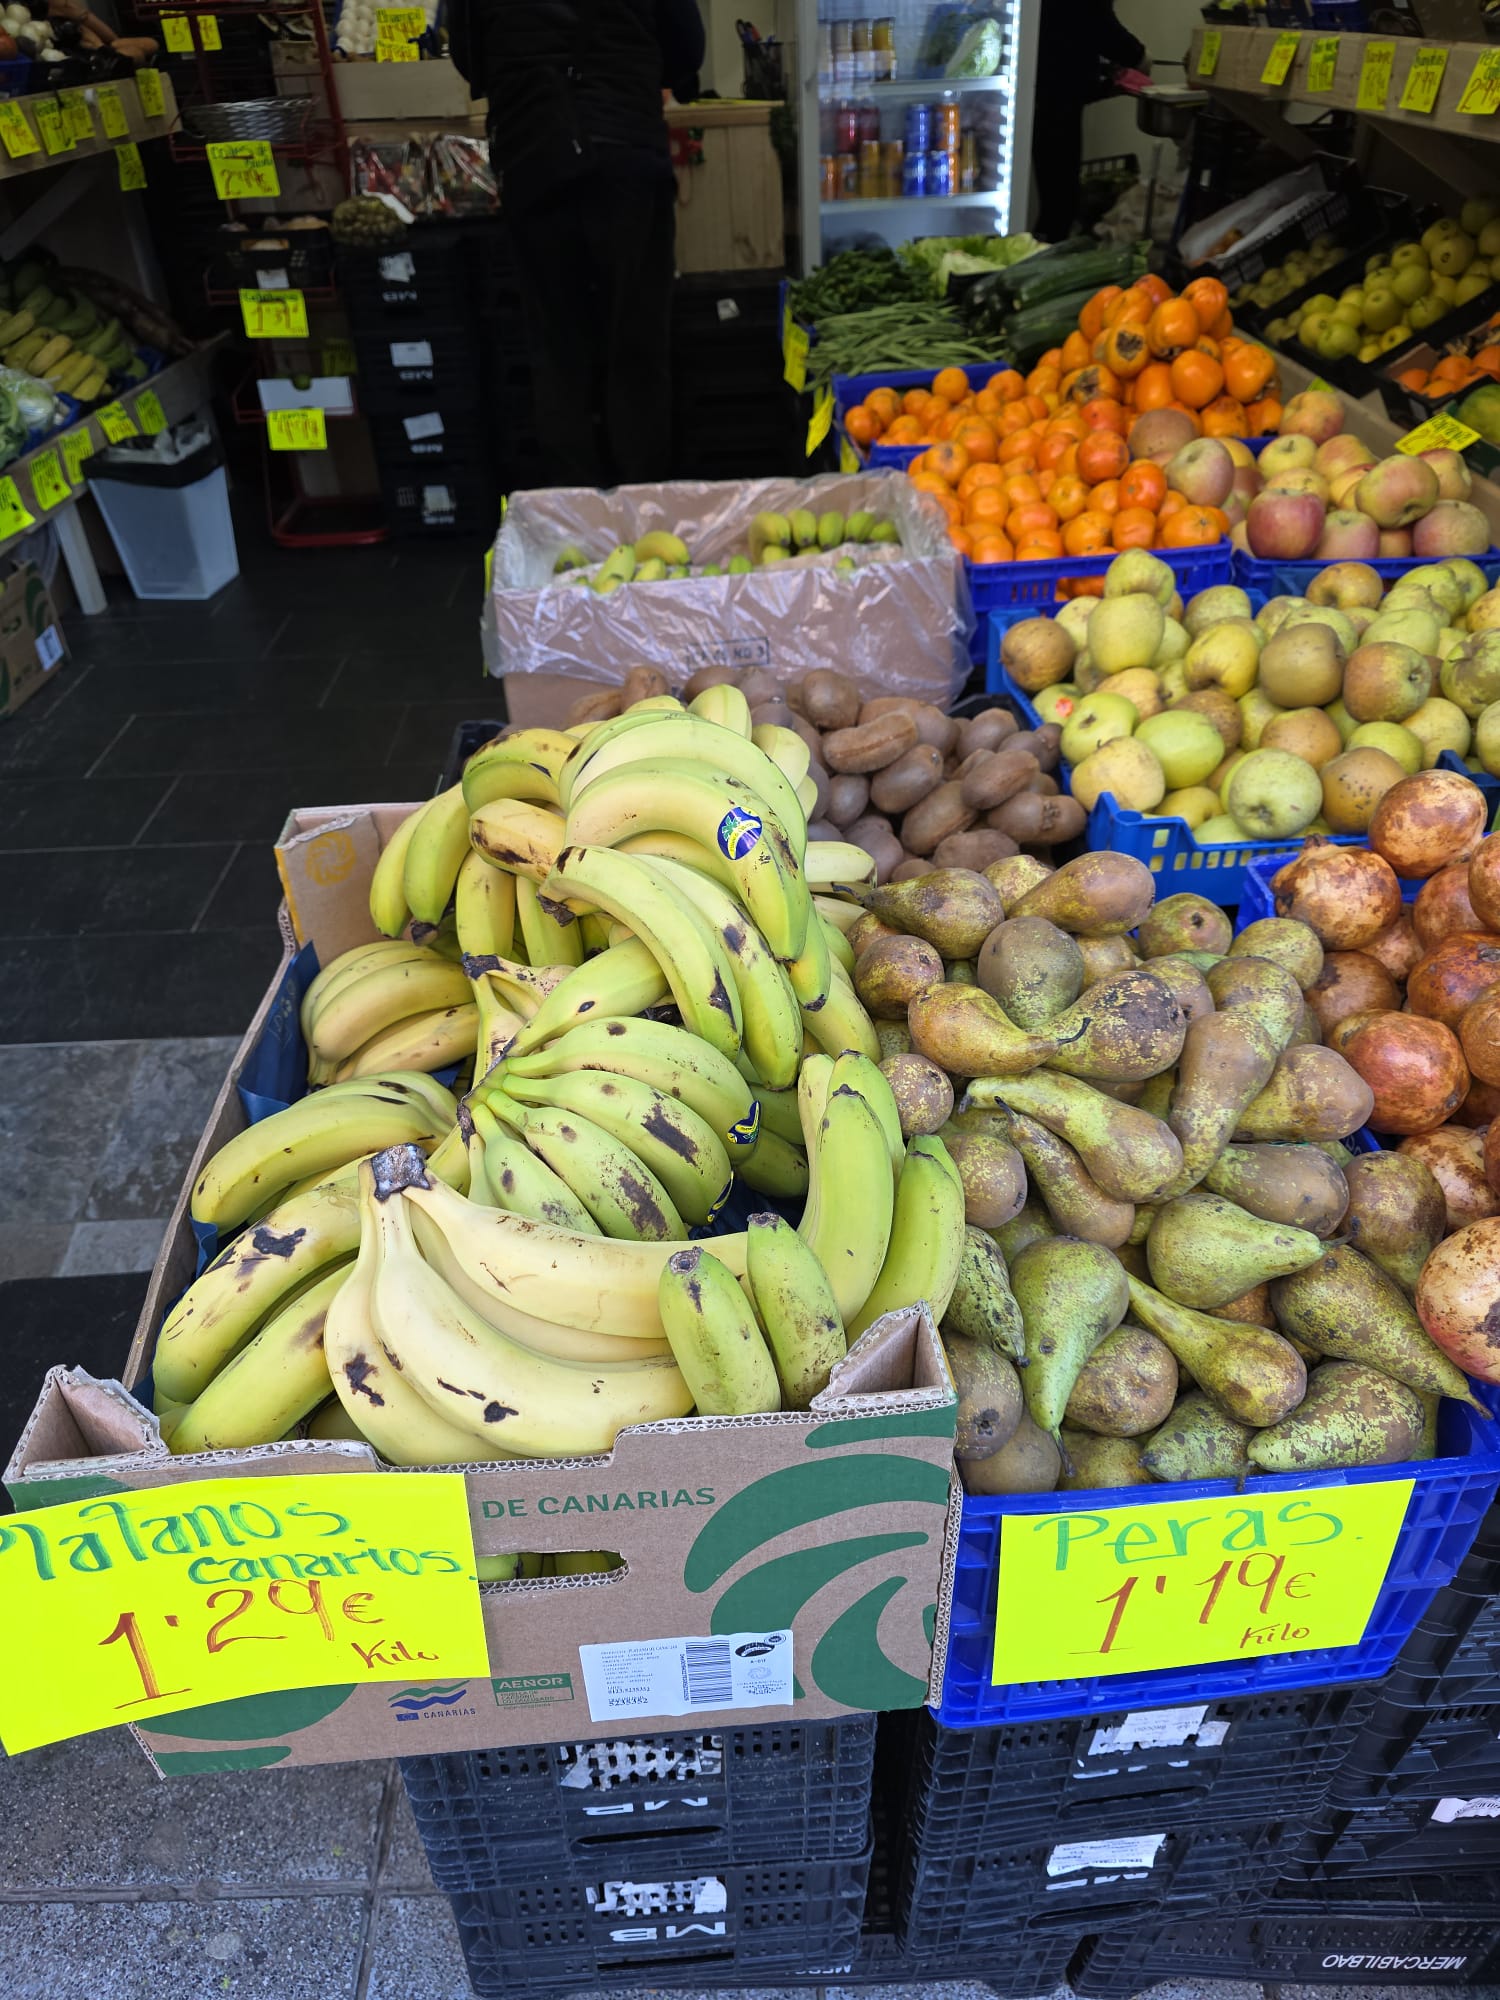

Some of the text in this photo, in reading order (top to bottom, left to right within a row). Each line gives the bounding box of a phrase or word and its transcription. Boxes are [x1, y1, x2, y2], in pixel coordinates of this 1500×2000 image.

[482, 1487, 716, 1519] DE CANARIAS
[499, 1677, 563, 1689] AENOR
[424, 1708, 476, 1719] CANARIAS
[609, 1921, 726, 1942] MB
[1322, 1954, 1467, 1970] MERCABILBAO
